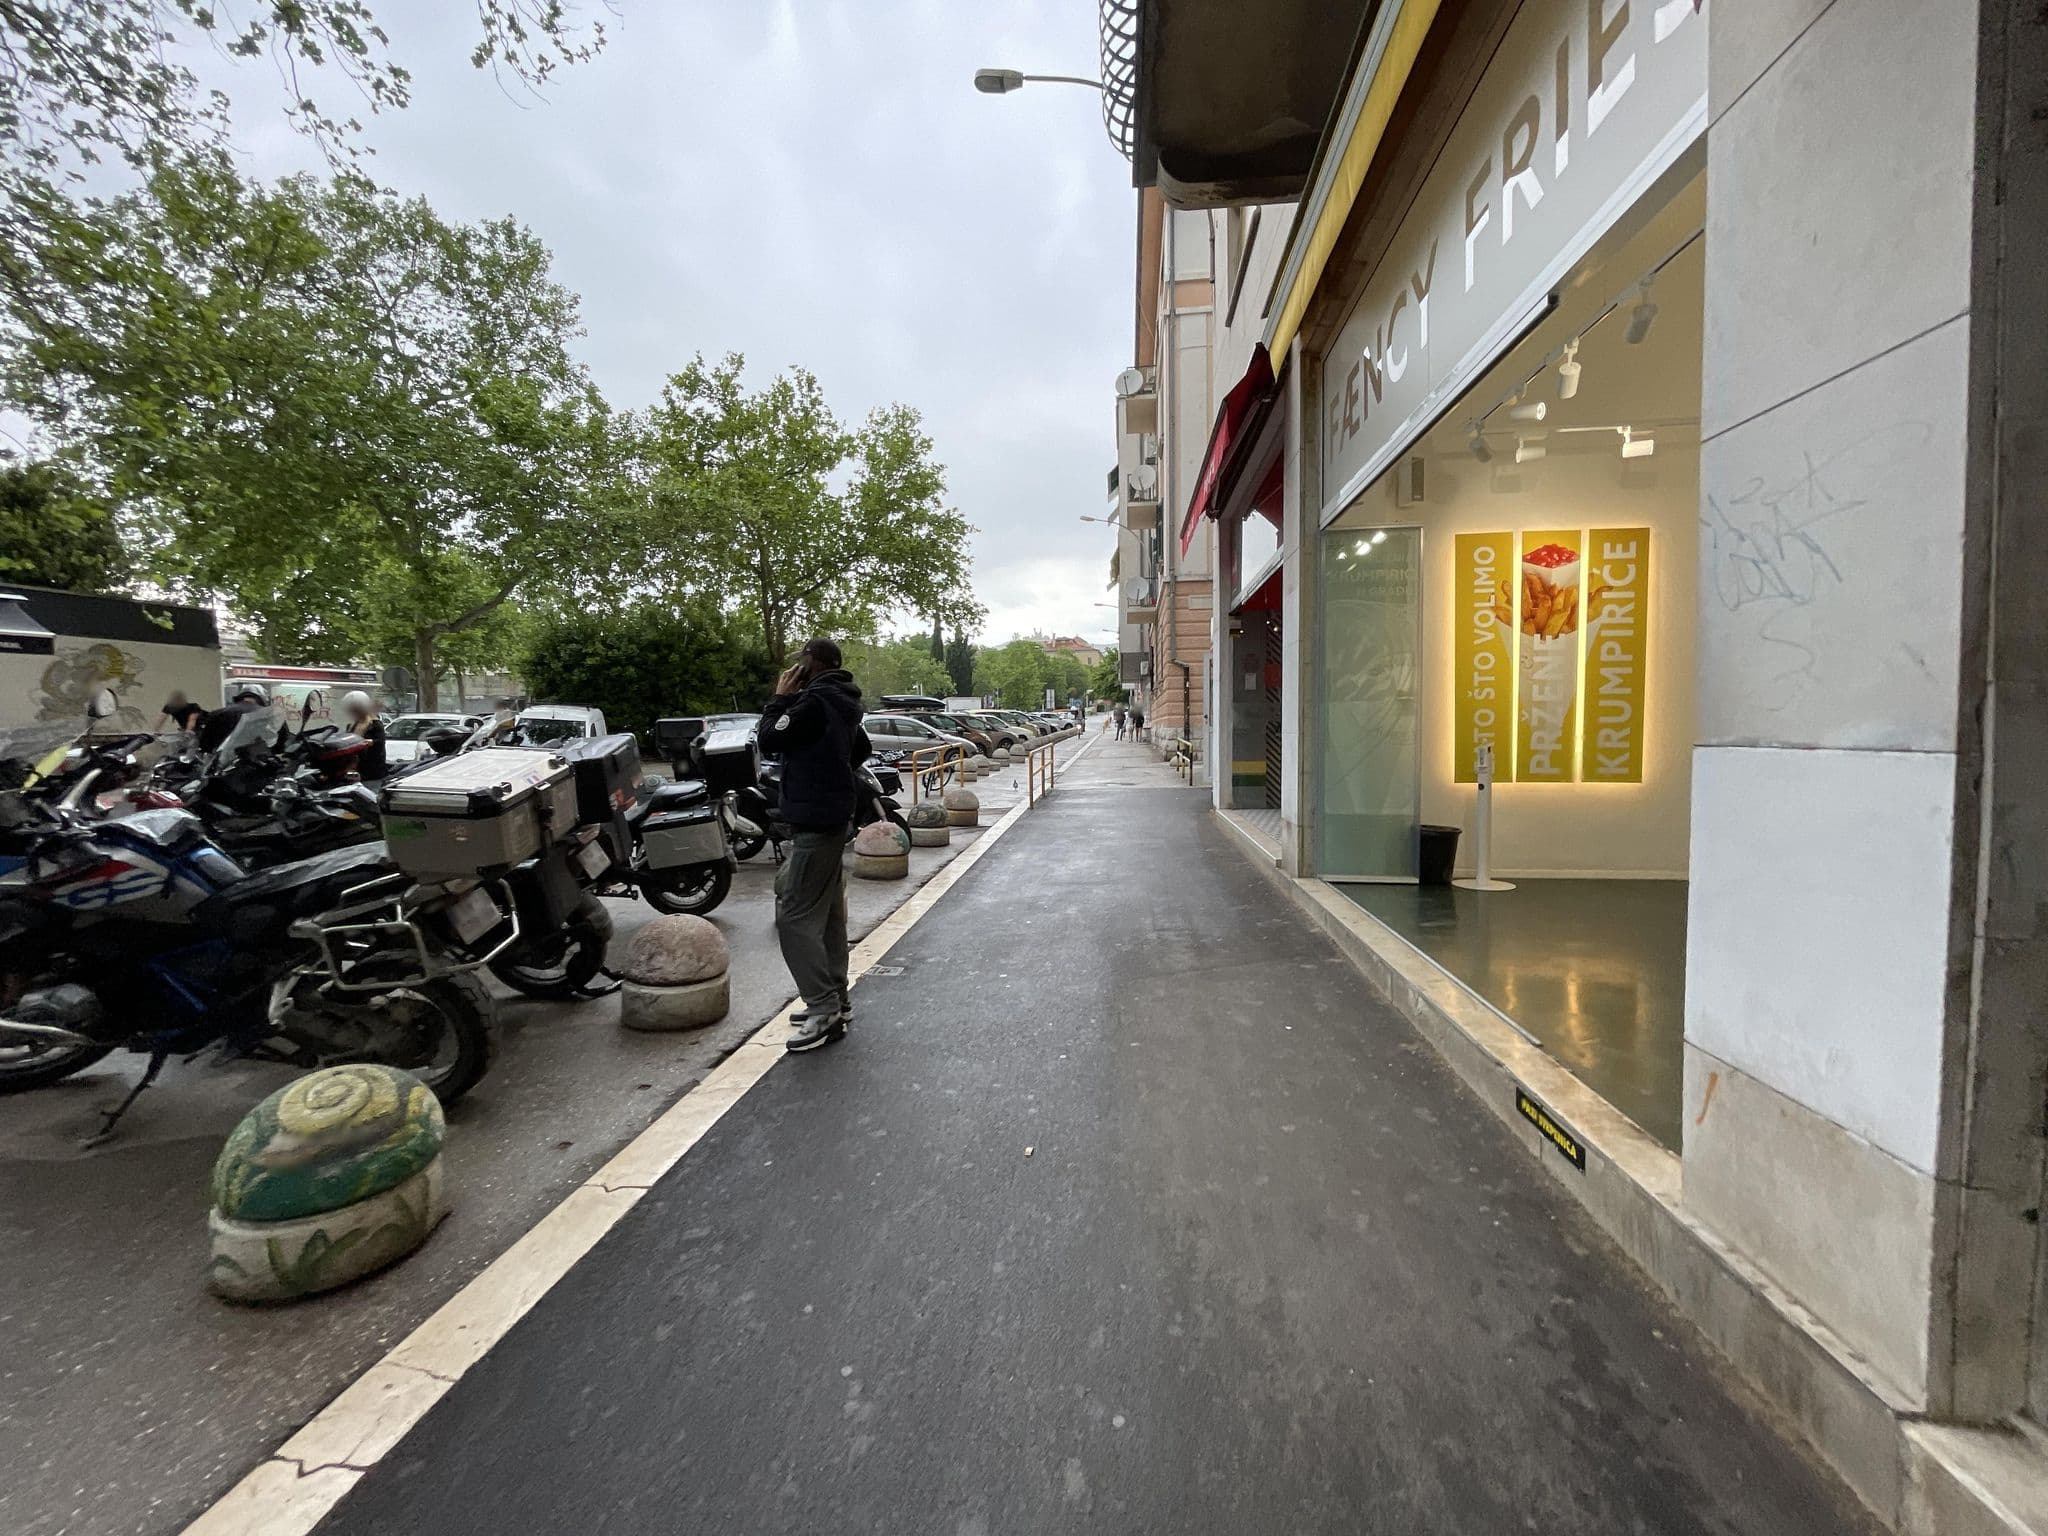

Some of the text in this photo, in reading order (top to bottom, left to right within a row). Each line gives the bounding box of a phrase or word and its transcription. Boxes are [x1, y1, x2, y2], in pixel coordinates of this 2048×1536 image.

[1464, 0, 1702, 294] FRIE
[1473, 546, 1496, 645] VOLIMO
[1592, 540, 1637, 775] KRUMPIRIĆE
[1467, 651, 1496, 700] ŠTO
[1522, 633, 1566, 774] PRŽENE
